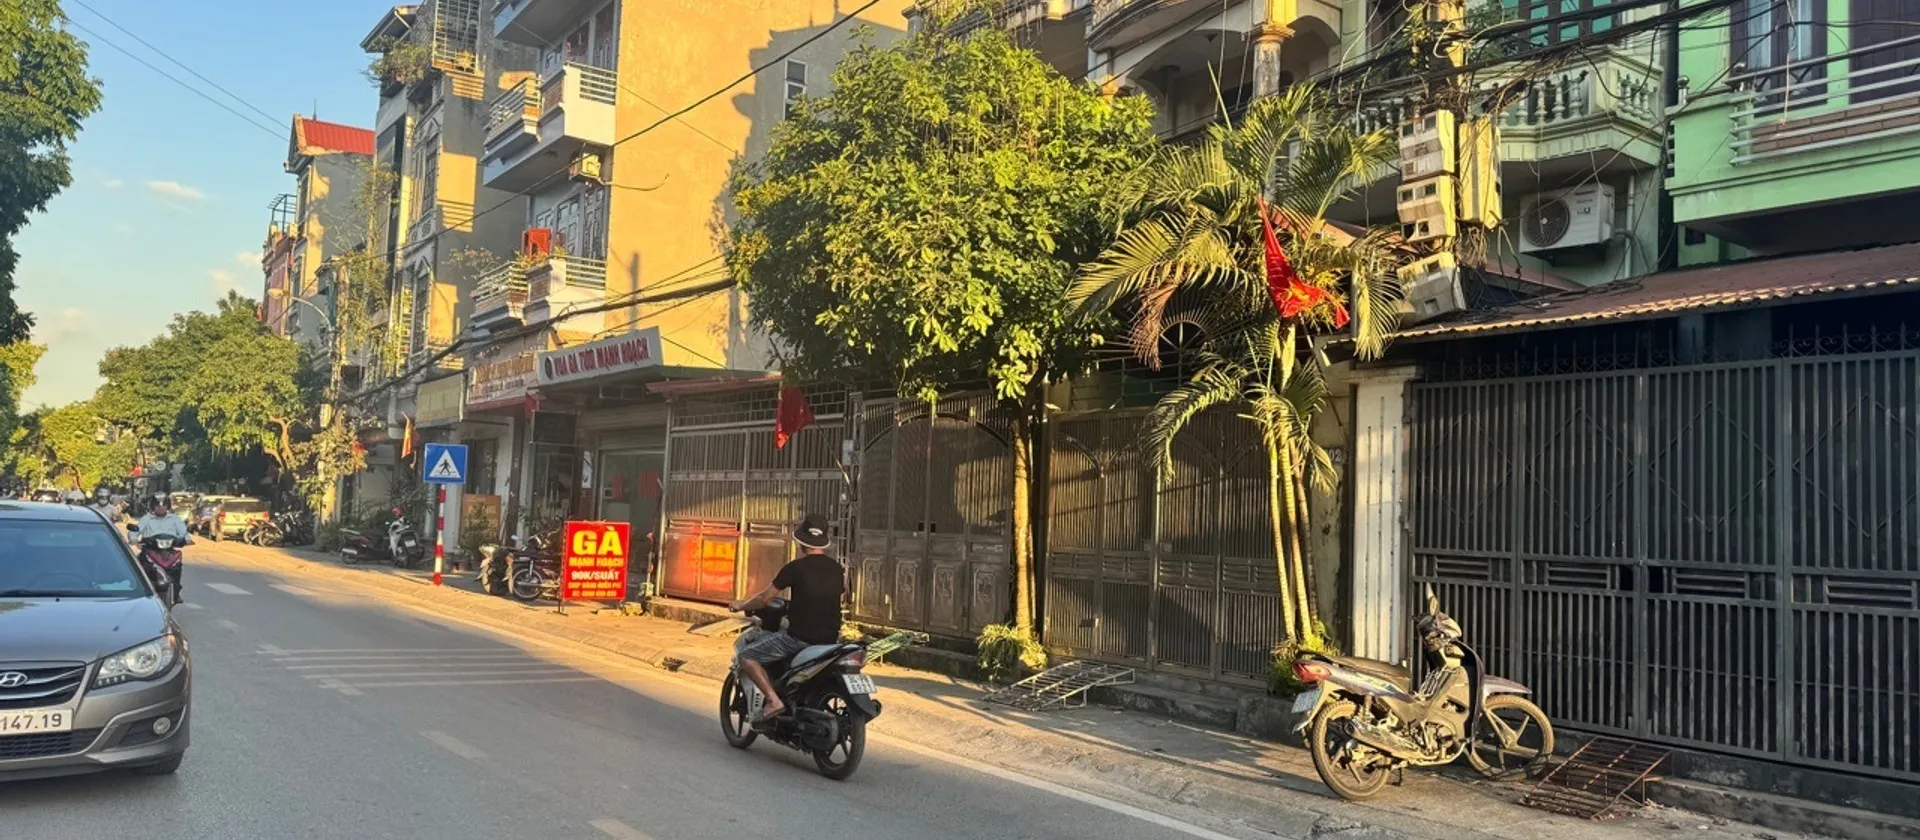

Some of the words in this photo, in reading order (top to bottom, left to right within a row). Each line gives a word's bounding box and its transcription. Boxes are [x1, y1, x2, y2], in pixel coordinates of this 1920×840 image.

[573, 525, 623, 556] GÀ
[571, 569, 620, 580] 90K/SUẤT
[0, 713, 62, 730] 147.19
